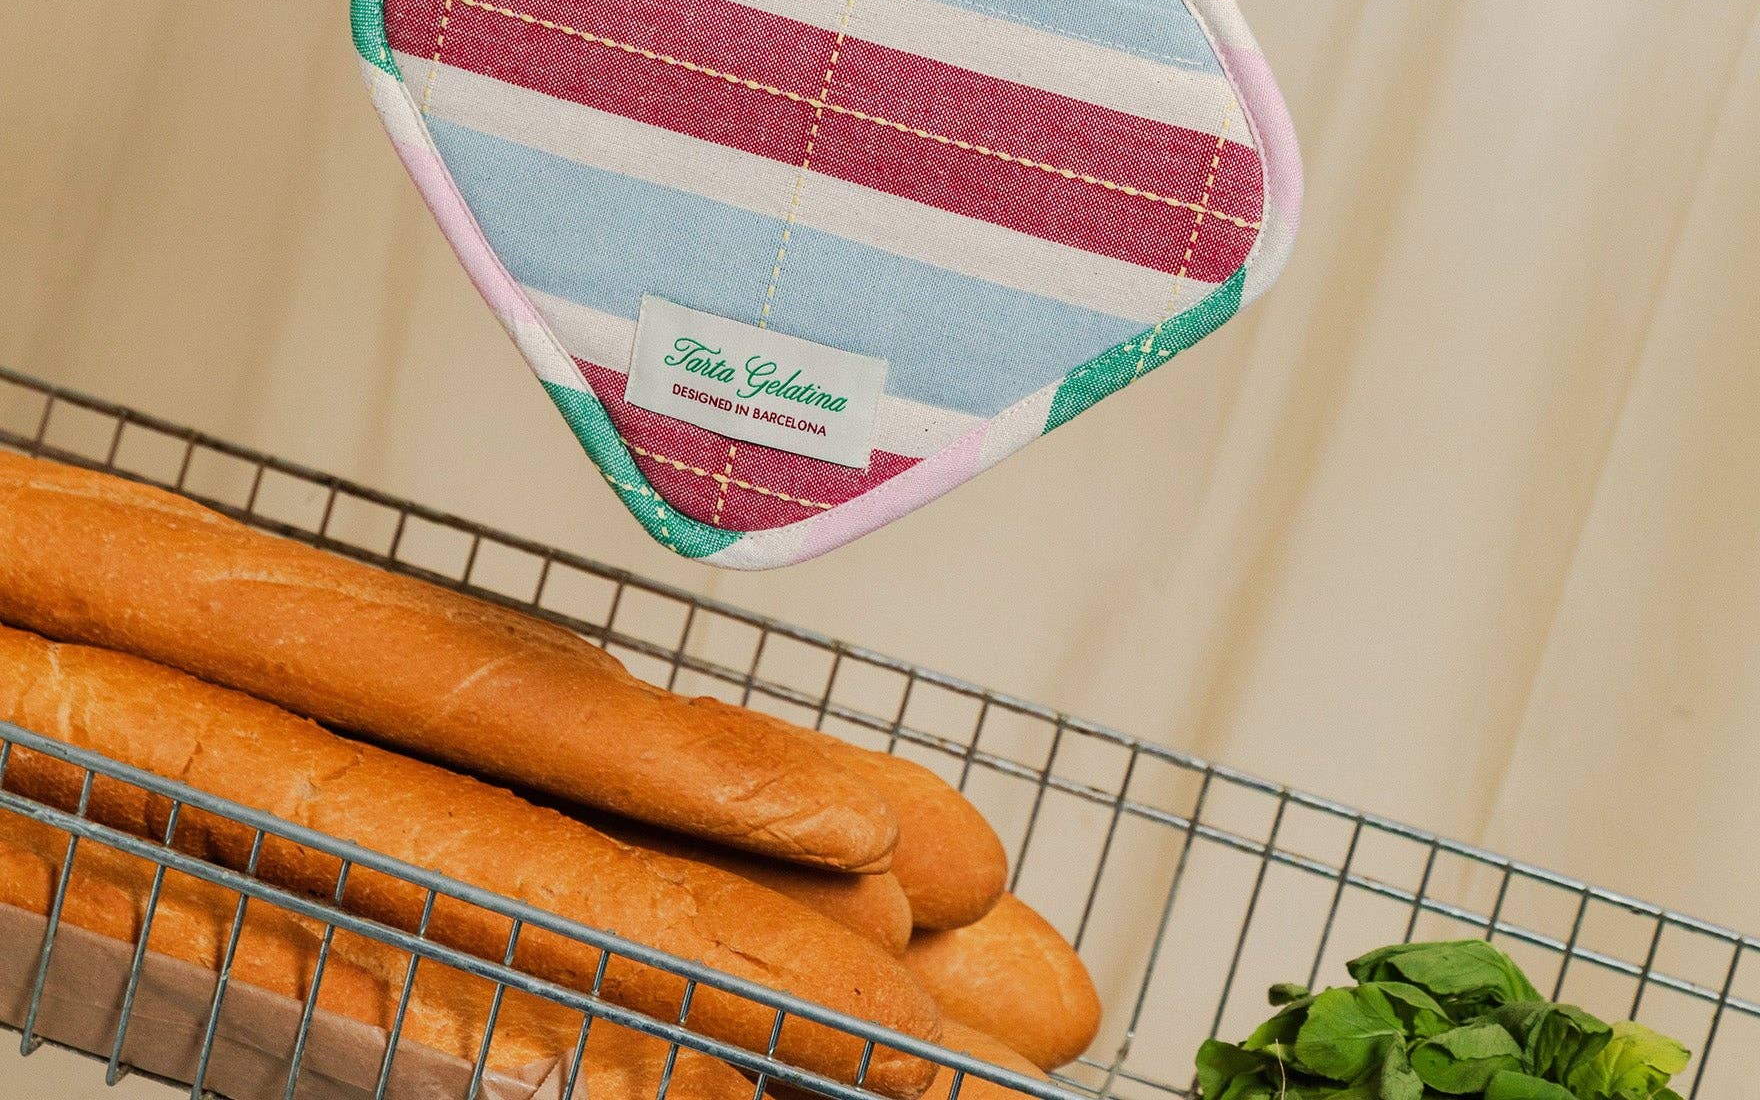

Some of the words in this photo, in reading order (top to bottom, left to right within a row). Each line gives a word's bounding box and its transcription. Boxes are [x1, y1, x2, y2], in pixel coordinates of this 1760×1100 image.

[664, 337, 736, 383] Tarta
[737, 355, 848, 413] Gelatina
[672, 383, 732, 412] DESIGNED
[735, 403, 750, 417] IN
[753, 408, 827, 437] BARCELONA
